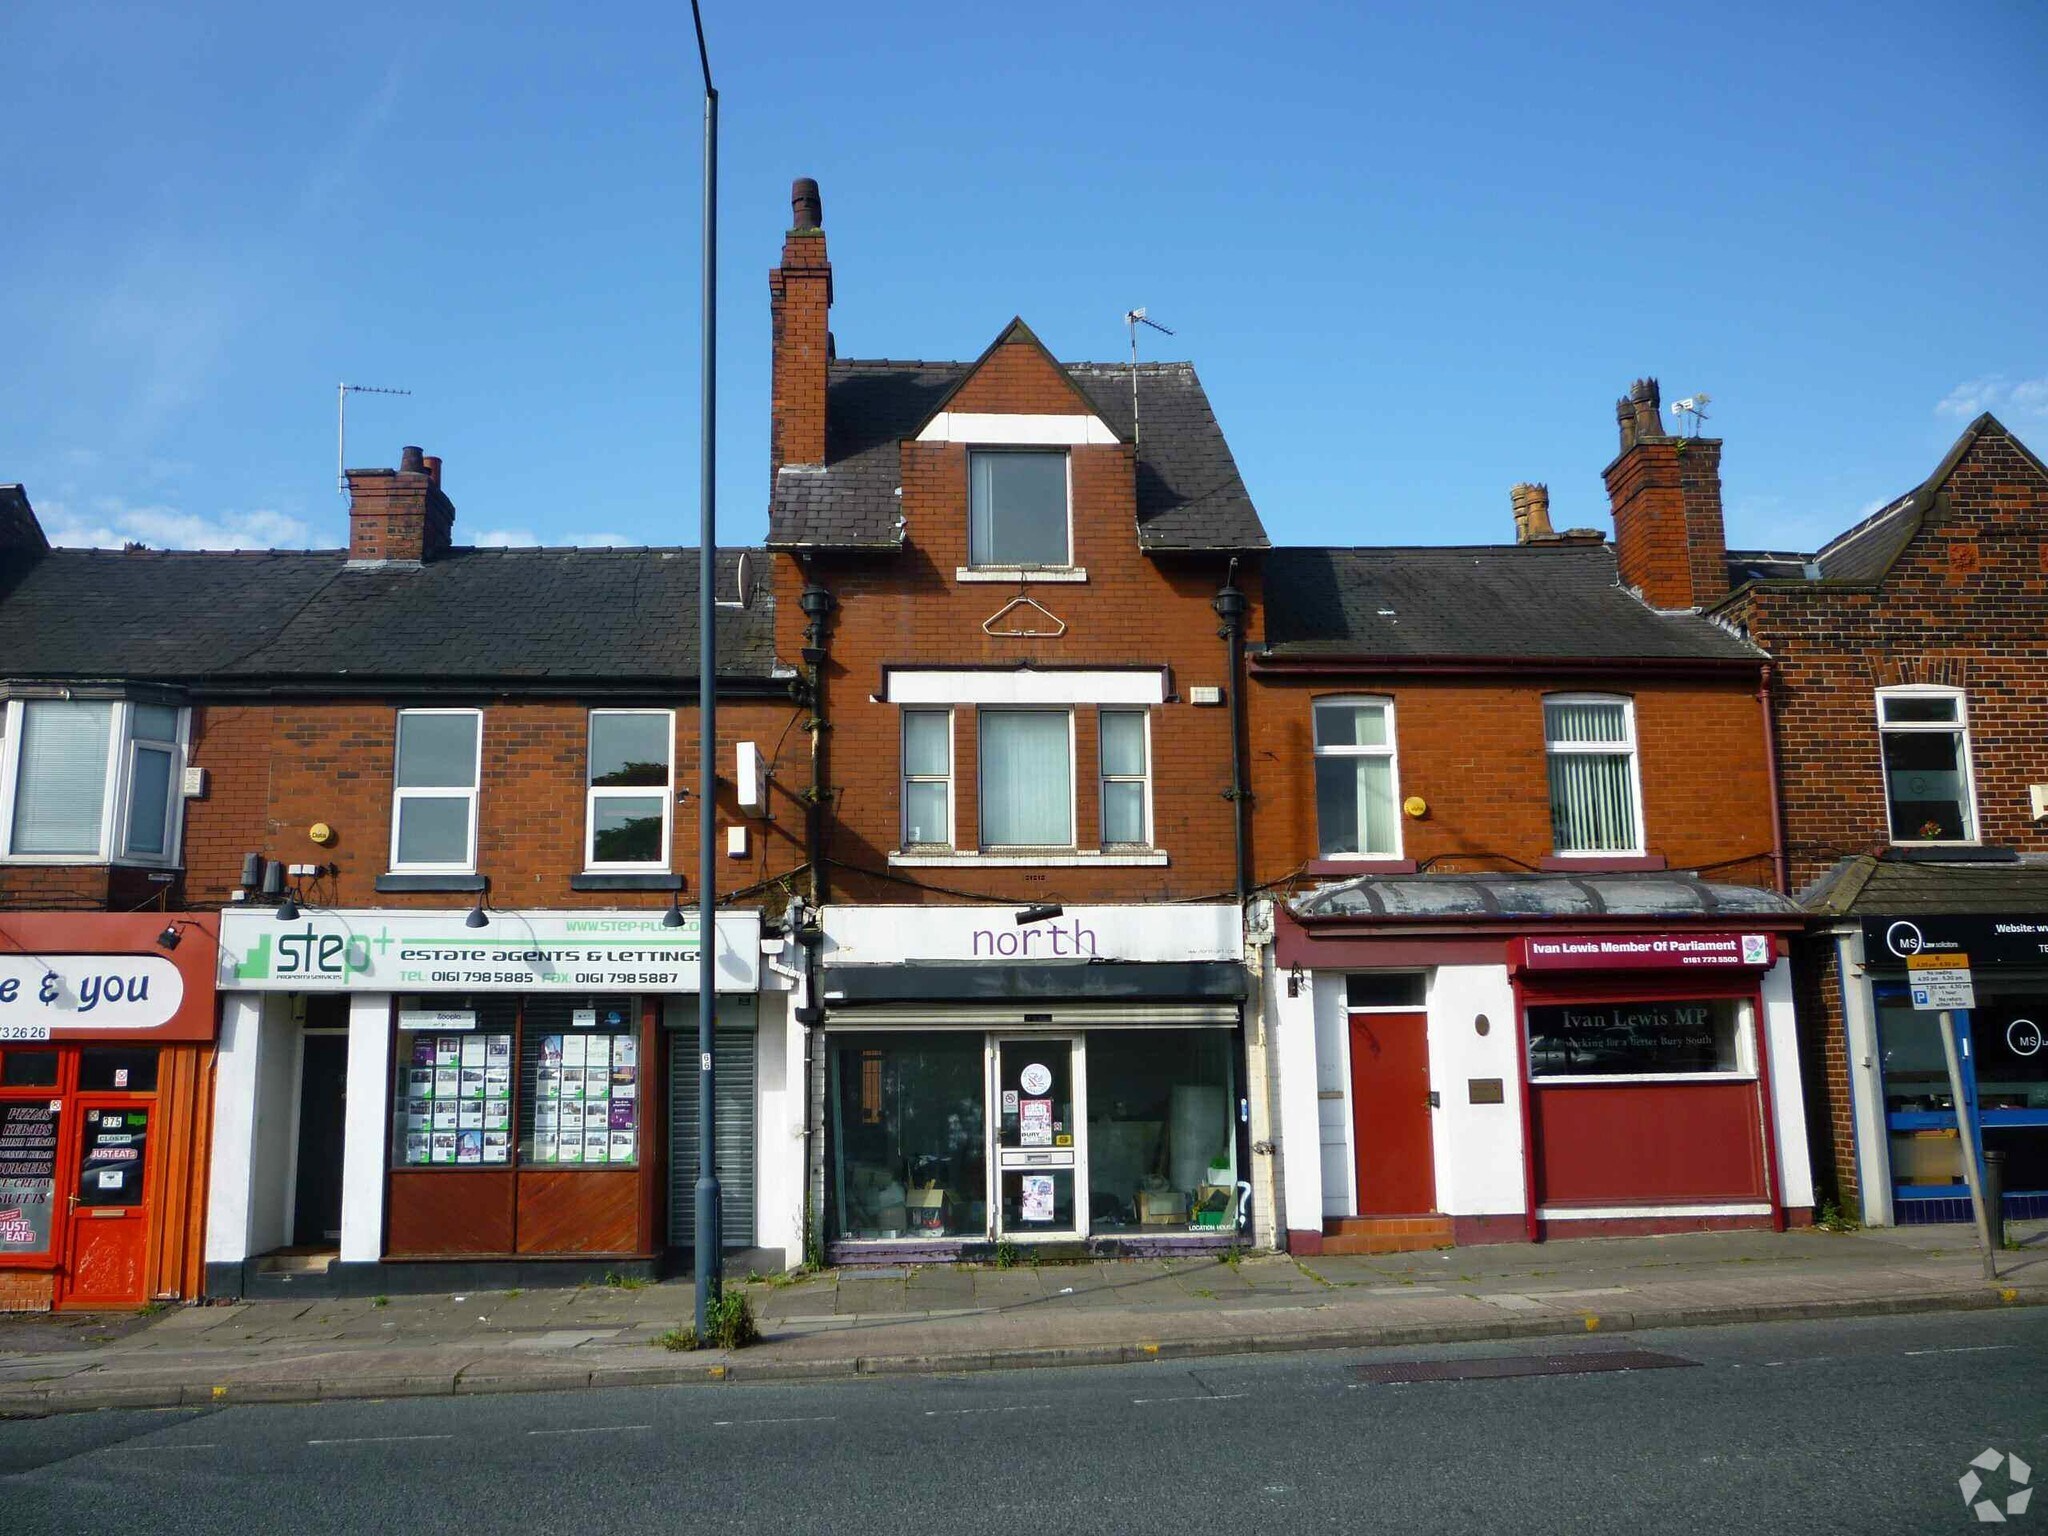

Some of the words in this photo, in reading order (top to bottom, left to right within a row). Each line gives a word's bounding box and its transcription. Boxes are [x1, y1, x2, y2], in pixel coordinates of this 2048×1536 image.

[1995, 923, 2036, 933] Website:
[974, 919, 1096, 956] north
[1899, 938, 1918, 948] MS
[1533, 943, 1561, 953] Ivan
[1562, 942, 1599, 953] Lewis
[1601, 941, 1651, 952] Member
[1653, 941, 1671, 952] Of
[1671, 940, 1736, 951] Parliament
[586, 951, 602, 962] &
[431, 971, 460, 982] 0161
[464, 972, 491, 983] 798
[494, 972, 533, 983] 5885
[575, 973, 604, 984] 0161
[608, 973, 636, 984] 798
[639, 973, 679, 984] 5887
[77, 975, 149, 1012] you
[1562, 1011, 1605, 1028] Ivan
[1613, 1009, 1668, 1026] Lewis
[1674, 1008, 1707, 1025] MP
[0, 1027, 9, 1038] 3
[12, 1027, 28, 1038] 26
[30, 1026, 46, 1038] 26
[1660, 1036, 1682, 1048] Bury
[1685, 1035, 1712, 1044] South
[2020, 1036, 2037, 1046] MS
[103, 1117, 121, 1127] 375
[92, 1150, 112, 1158] JUST
[114, 1149, 130, 1158] EAT
[0, 1221, 28, 1231] JUST
[6, 1231, 27, 1241] EAT
